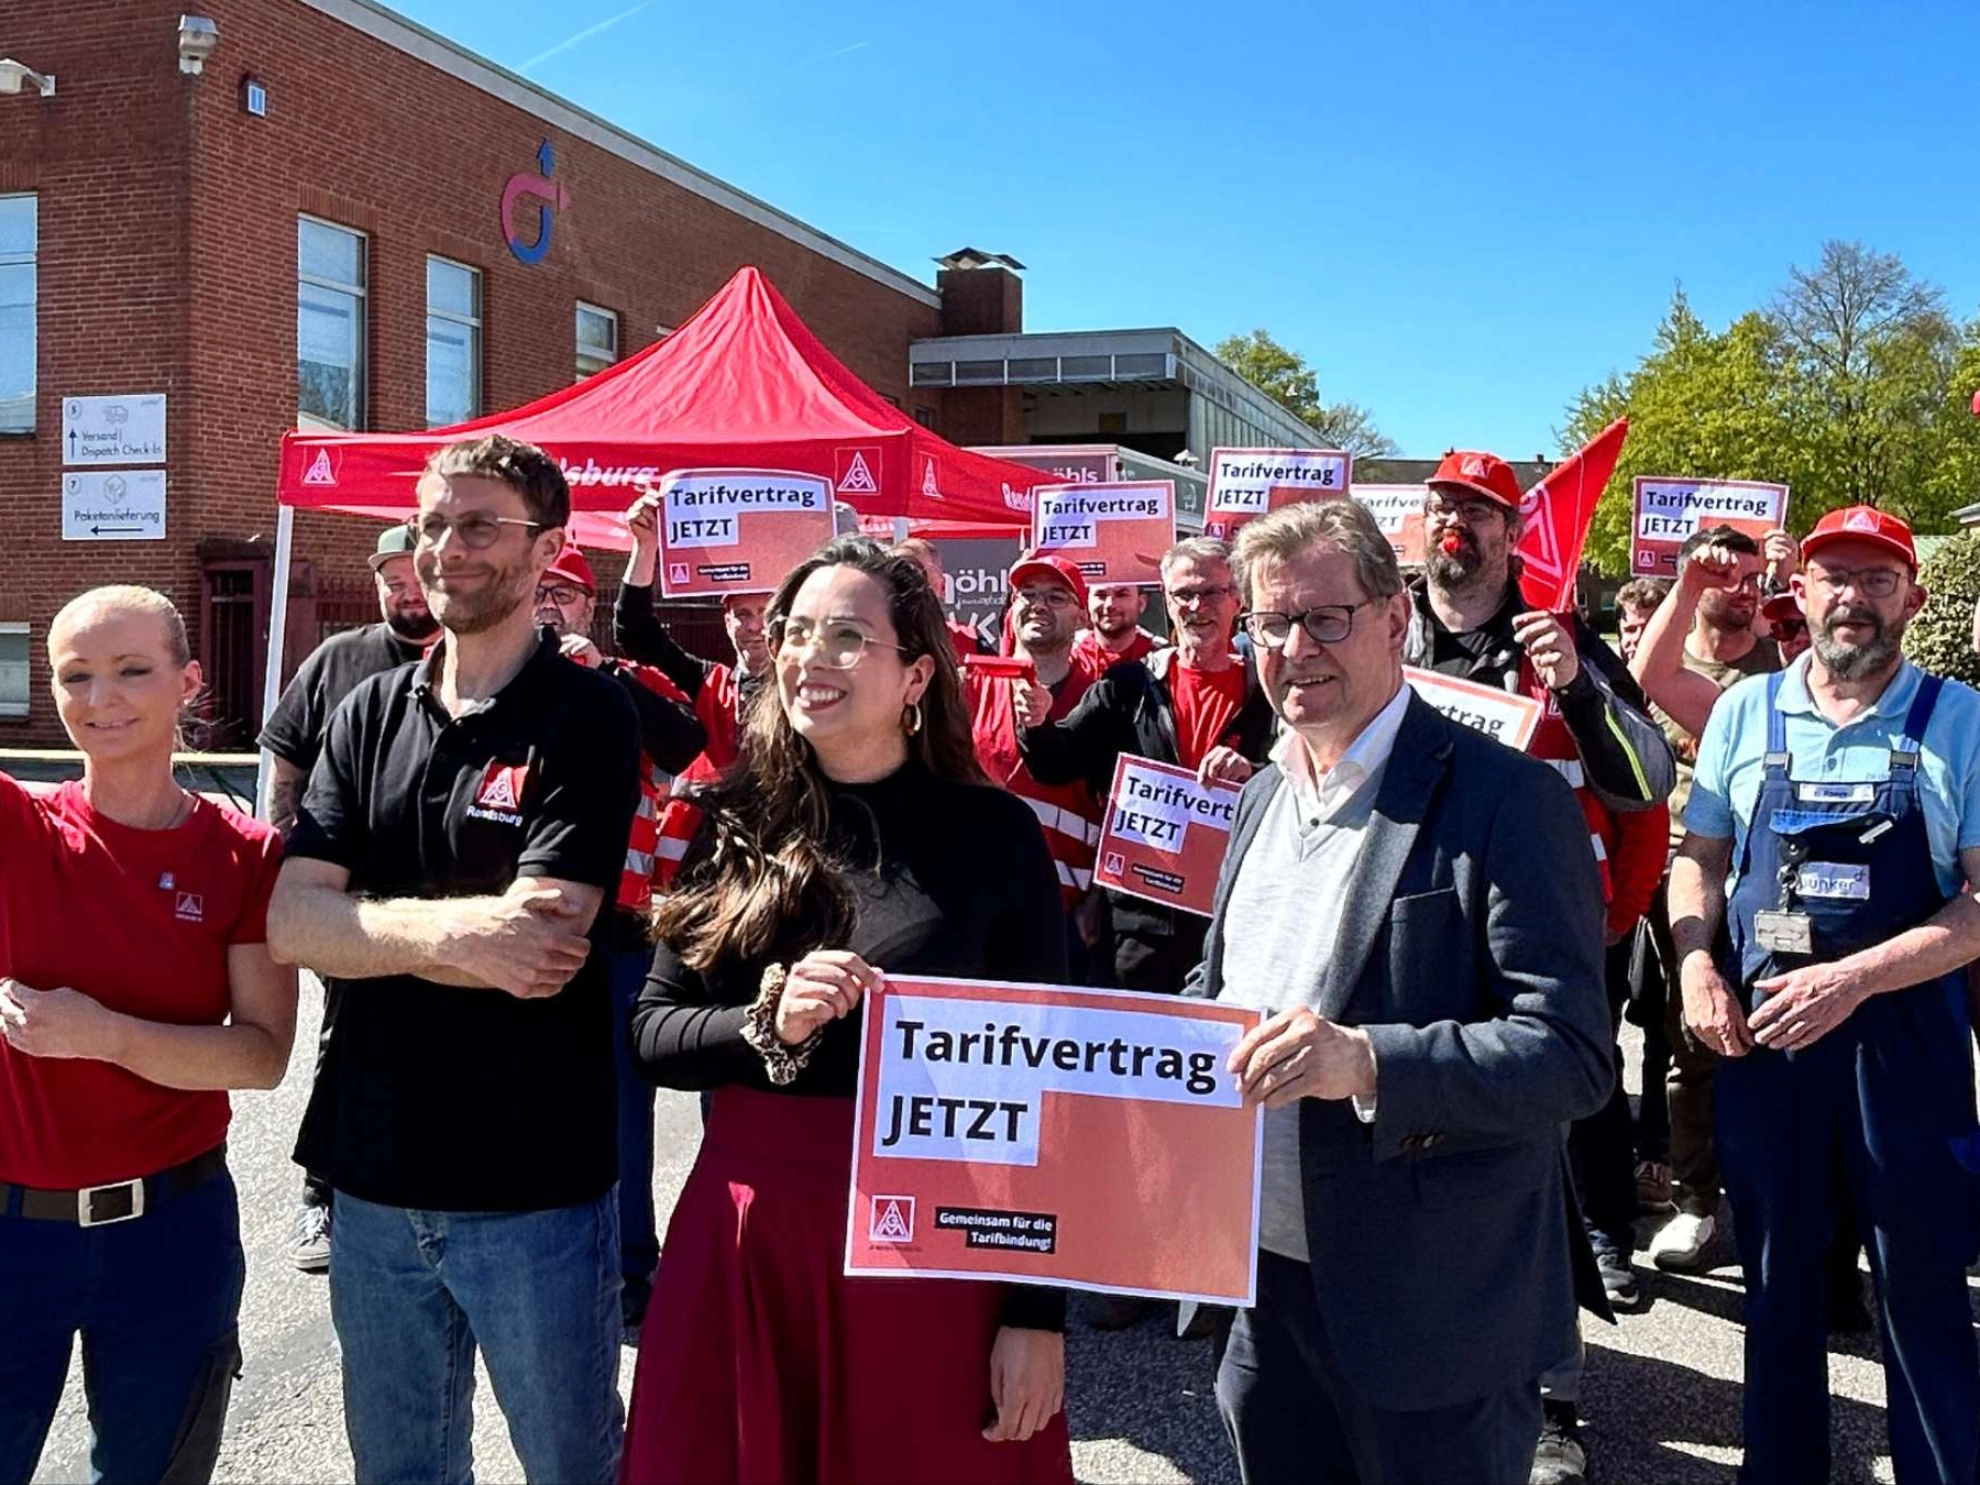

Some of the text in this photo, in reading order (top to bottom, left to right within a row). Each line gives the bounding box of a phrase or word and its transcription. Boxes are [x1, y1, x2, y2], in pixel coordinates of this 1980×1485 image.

[82, 430, 117, 441] Versand
[1221, 462, 1334, 485] Tarifvertrag
[671, 485, 815, 508] Tarifvertrag
[1043, 497, 1158, 515] Tarifvertrag
[1216, 489, 1265, 507] JETZT
[1647, 491, 1767, 516] Tarifvertrag
[670, 518, 732, 544] JETZT
[1041, 525, 1091, 545] JETZT
[1642, 517, 1694, 535] JETZT
[1114, 810, 1181, 842] JETZT
[896, 1020, 1216, 1094] Tarifvertrag
[882, 1095, 1028, 1146] JETZT
[939, 1212, 1053, 1231] Gemeinsam für die
